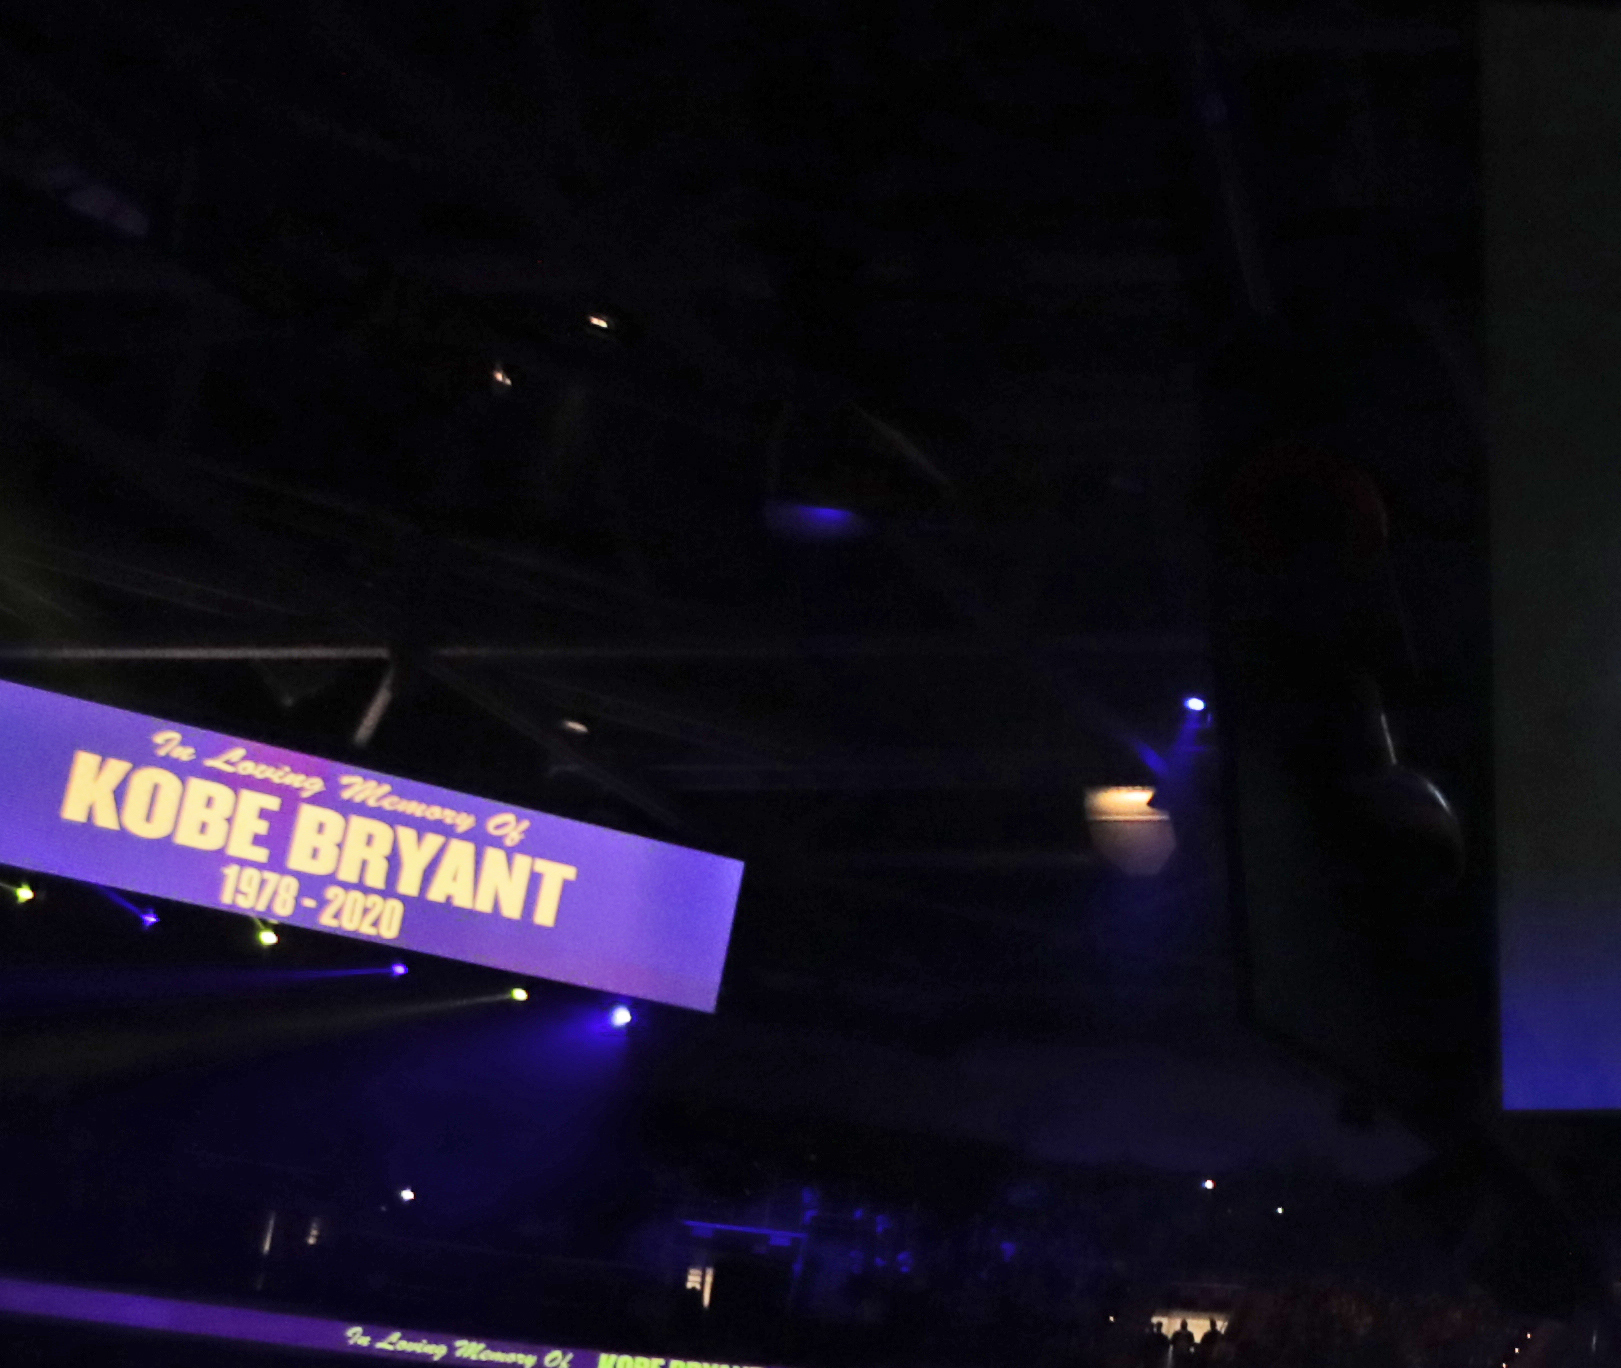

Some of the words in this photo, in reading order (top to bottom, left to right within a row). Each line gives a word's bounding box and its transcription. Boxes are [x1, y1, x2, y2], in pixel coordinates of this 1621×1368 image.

[151, 730, 196, 761] In
[204, 746, 325, 798] Loving
[340, 773, 475, 832] Memory
[484, 813, 530, 845] Of
[60, 749, 282, 863] KOBE
[286, 802, 577, 927] BRYANT
[218, 864, 299, 917] 1978
[319, 886, 405, 939] 2020
[345, 1327, 371, 1347] In
[375, 1332, 448, 1360] Loving
[454, 1340, 537, 1368] Memory
